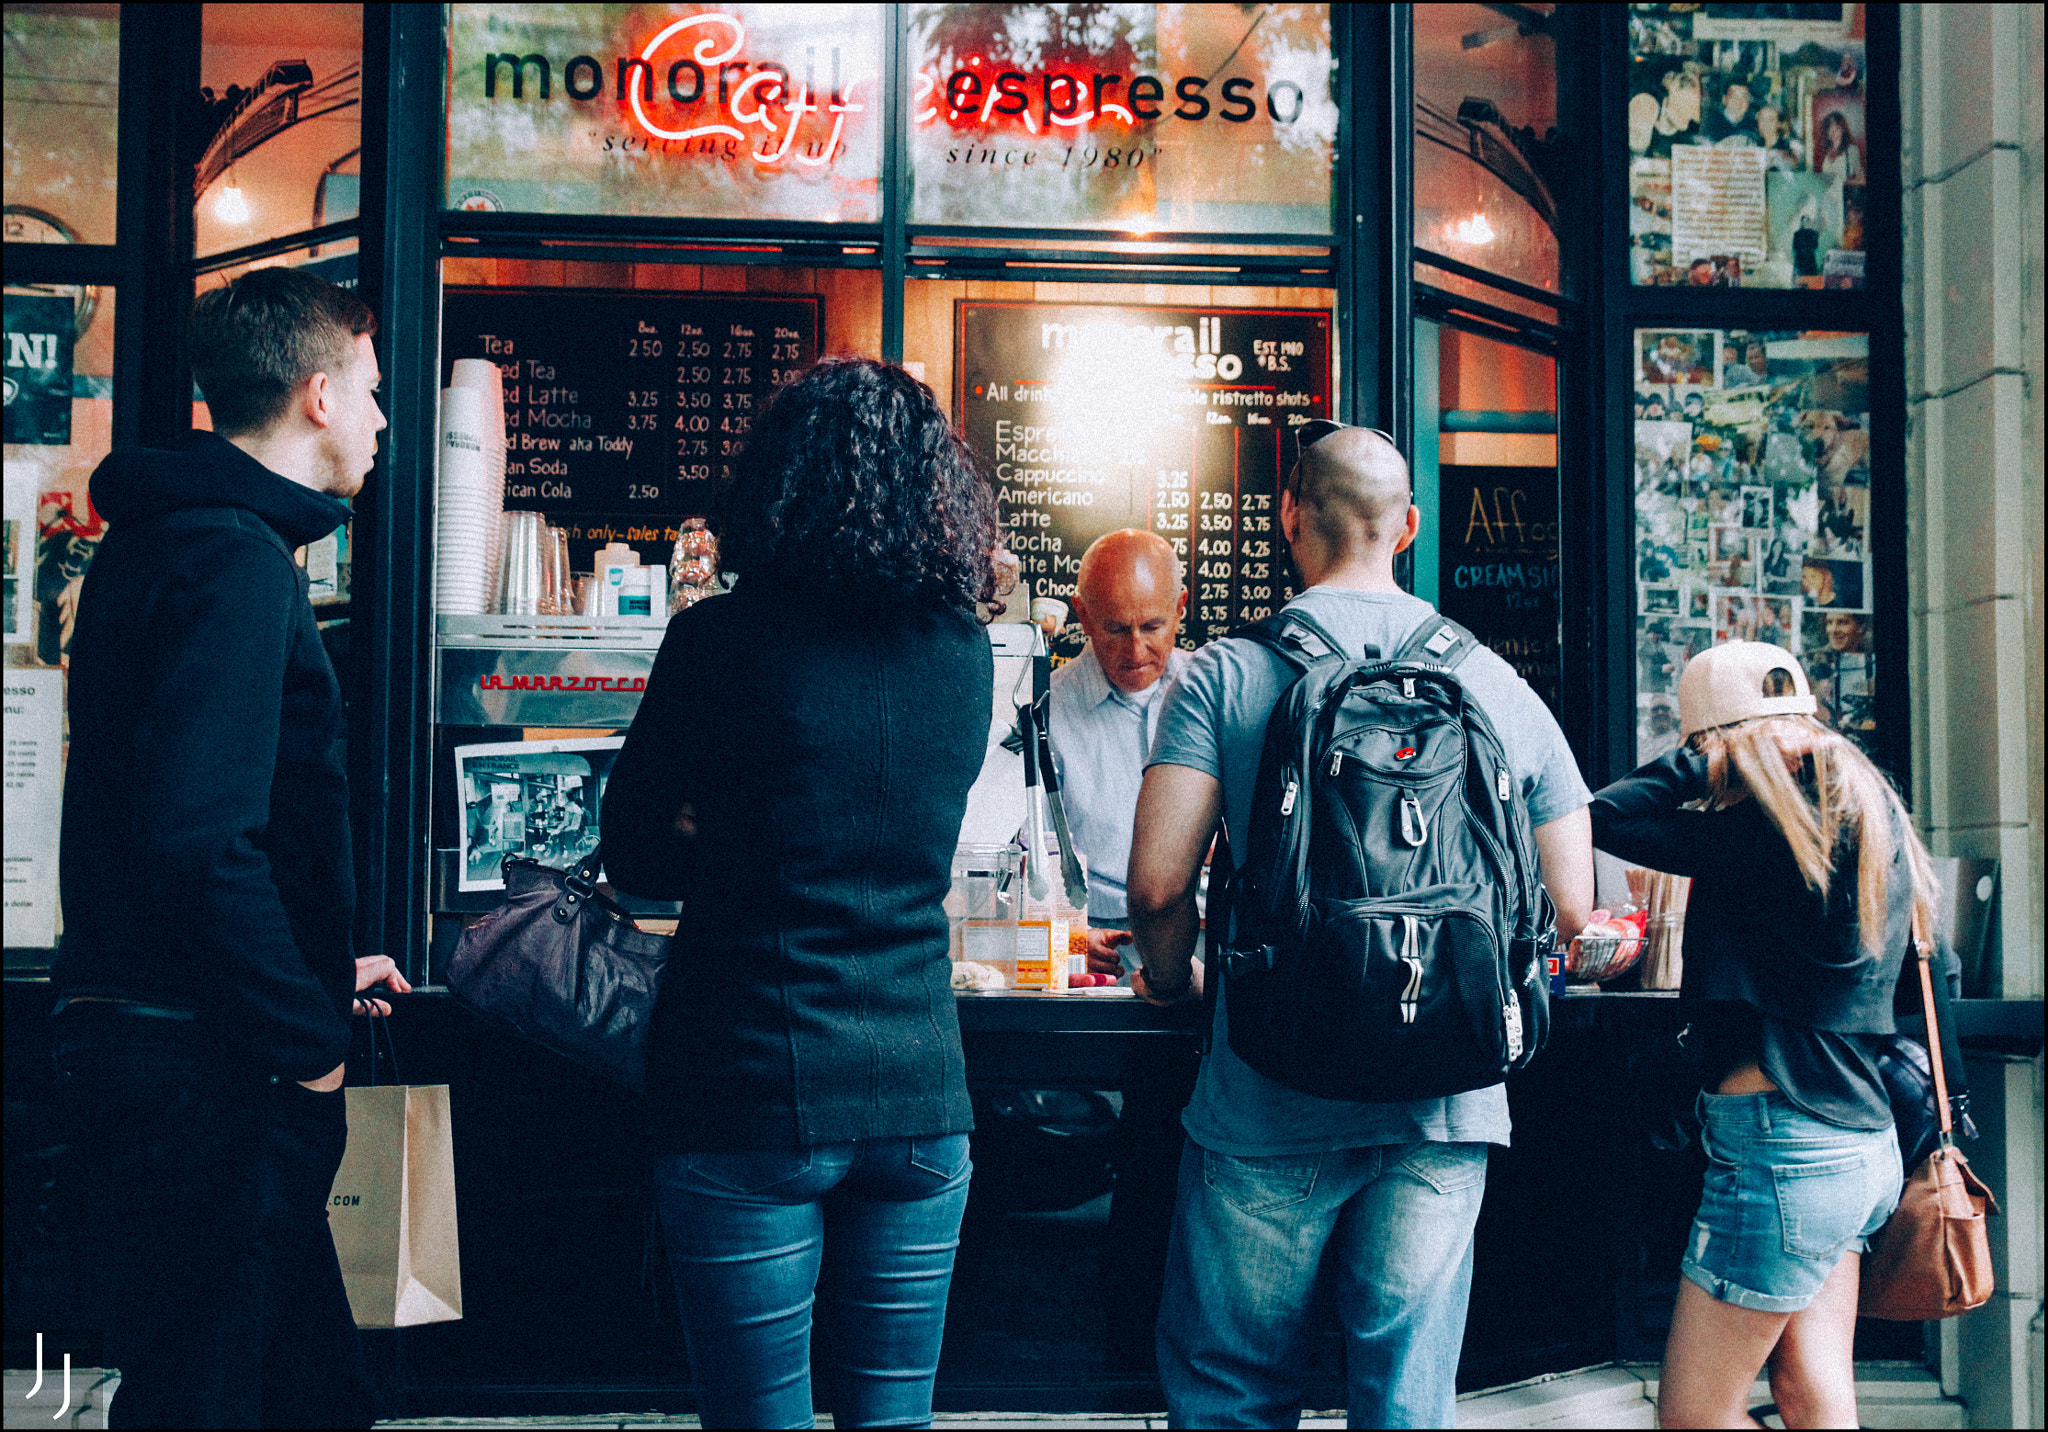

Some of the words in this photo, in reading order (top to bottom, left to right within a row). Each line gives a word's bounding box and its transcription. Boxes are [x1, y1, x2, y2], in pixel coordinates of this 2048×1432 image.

[484, 45, 845, 104] monorail
[946, 69, 1303, 126] espresso
[946, 143, 1037, 165] since
[3, 332, 58, 369] N!
[478, 334, 514, 354] Tea
[677, 340, 711, 358] 2.50
[723, 342, 752, 359] 2.75
[771, 343, 800, 361] 2.75
[501, 360, 520, 379] ed
[526, 359, 556, 380] Tea
[677, 366, 711, 384] 2.50
[723, 367, 752, 384] 2.75
[503, 385, 520, 404] ed
[529, 384, 579, 405] Latte
[627, 391, 659, 407] 3.25
[677, 391, 711, 409] 3.50
[723, 393, 752, 410] 3.75
[986, 381, 1009, 402] All
[1212, 388, 1274, 406] ristretto
[1276, 391, 1311, 407] shots
[528, 408, 592, 429] Mocha
[627, 414, 658, 431] 3.75
[674, 415, 710, 432] 4.00
[521, 433, 561, 451] Brew
[569, 436, 593, 451] aka
[595, 435, 633, 460] Toddy
[677, 439, 709, 456] 2.75
[528, 457, 568, 475] Soda
[677, 464, 710, 480] 3.50
[996, 462, 1107, 487] Cappuccino
[1157, 470, 1189, 489] 3.25
[540, 481, 572, 499] Cola
[628, 484, 660, 499] 2.50
[997, 485, 1095, 506] Americano
[1156, 491, 1190, 509] 2.50
[1200, 491, 1233, 510] 2.50
[1241, 493, 1272, 511] 2.75
[995, 508, 1051, 528] Latte
[1156, 511, 1189, 530] 3.25
[1200, 514, 1233, 532] 3.50
[1242, 516, 1271, 532] 3.75
[664, 525, 681, 541] ta
[1198, 537, 1232, 556] 4.00
[1241, 539, 1271, 558] 4.25
[1198, 560, 1232, 579] 4.00
[1240, 562, 1270, 580] 4.25
[1200, 582, 1229, 601] 2.75
[1241, 585, 1272, 601] 3.00
[1200, 605, 1228, 621] 3.75
[1239, 605, 1272, 621] 4.00
[4, 686, 36, 696] esso
[480, 674, 502, 690] LA
[513, 675, 646, 692] MARZOCCO
